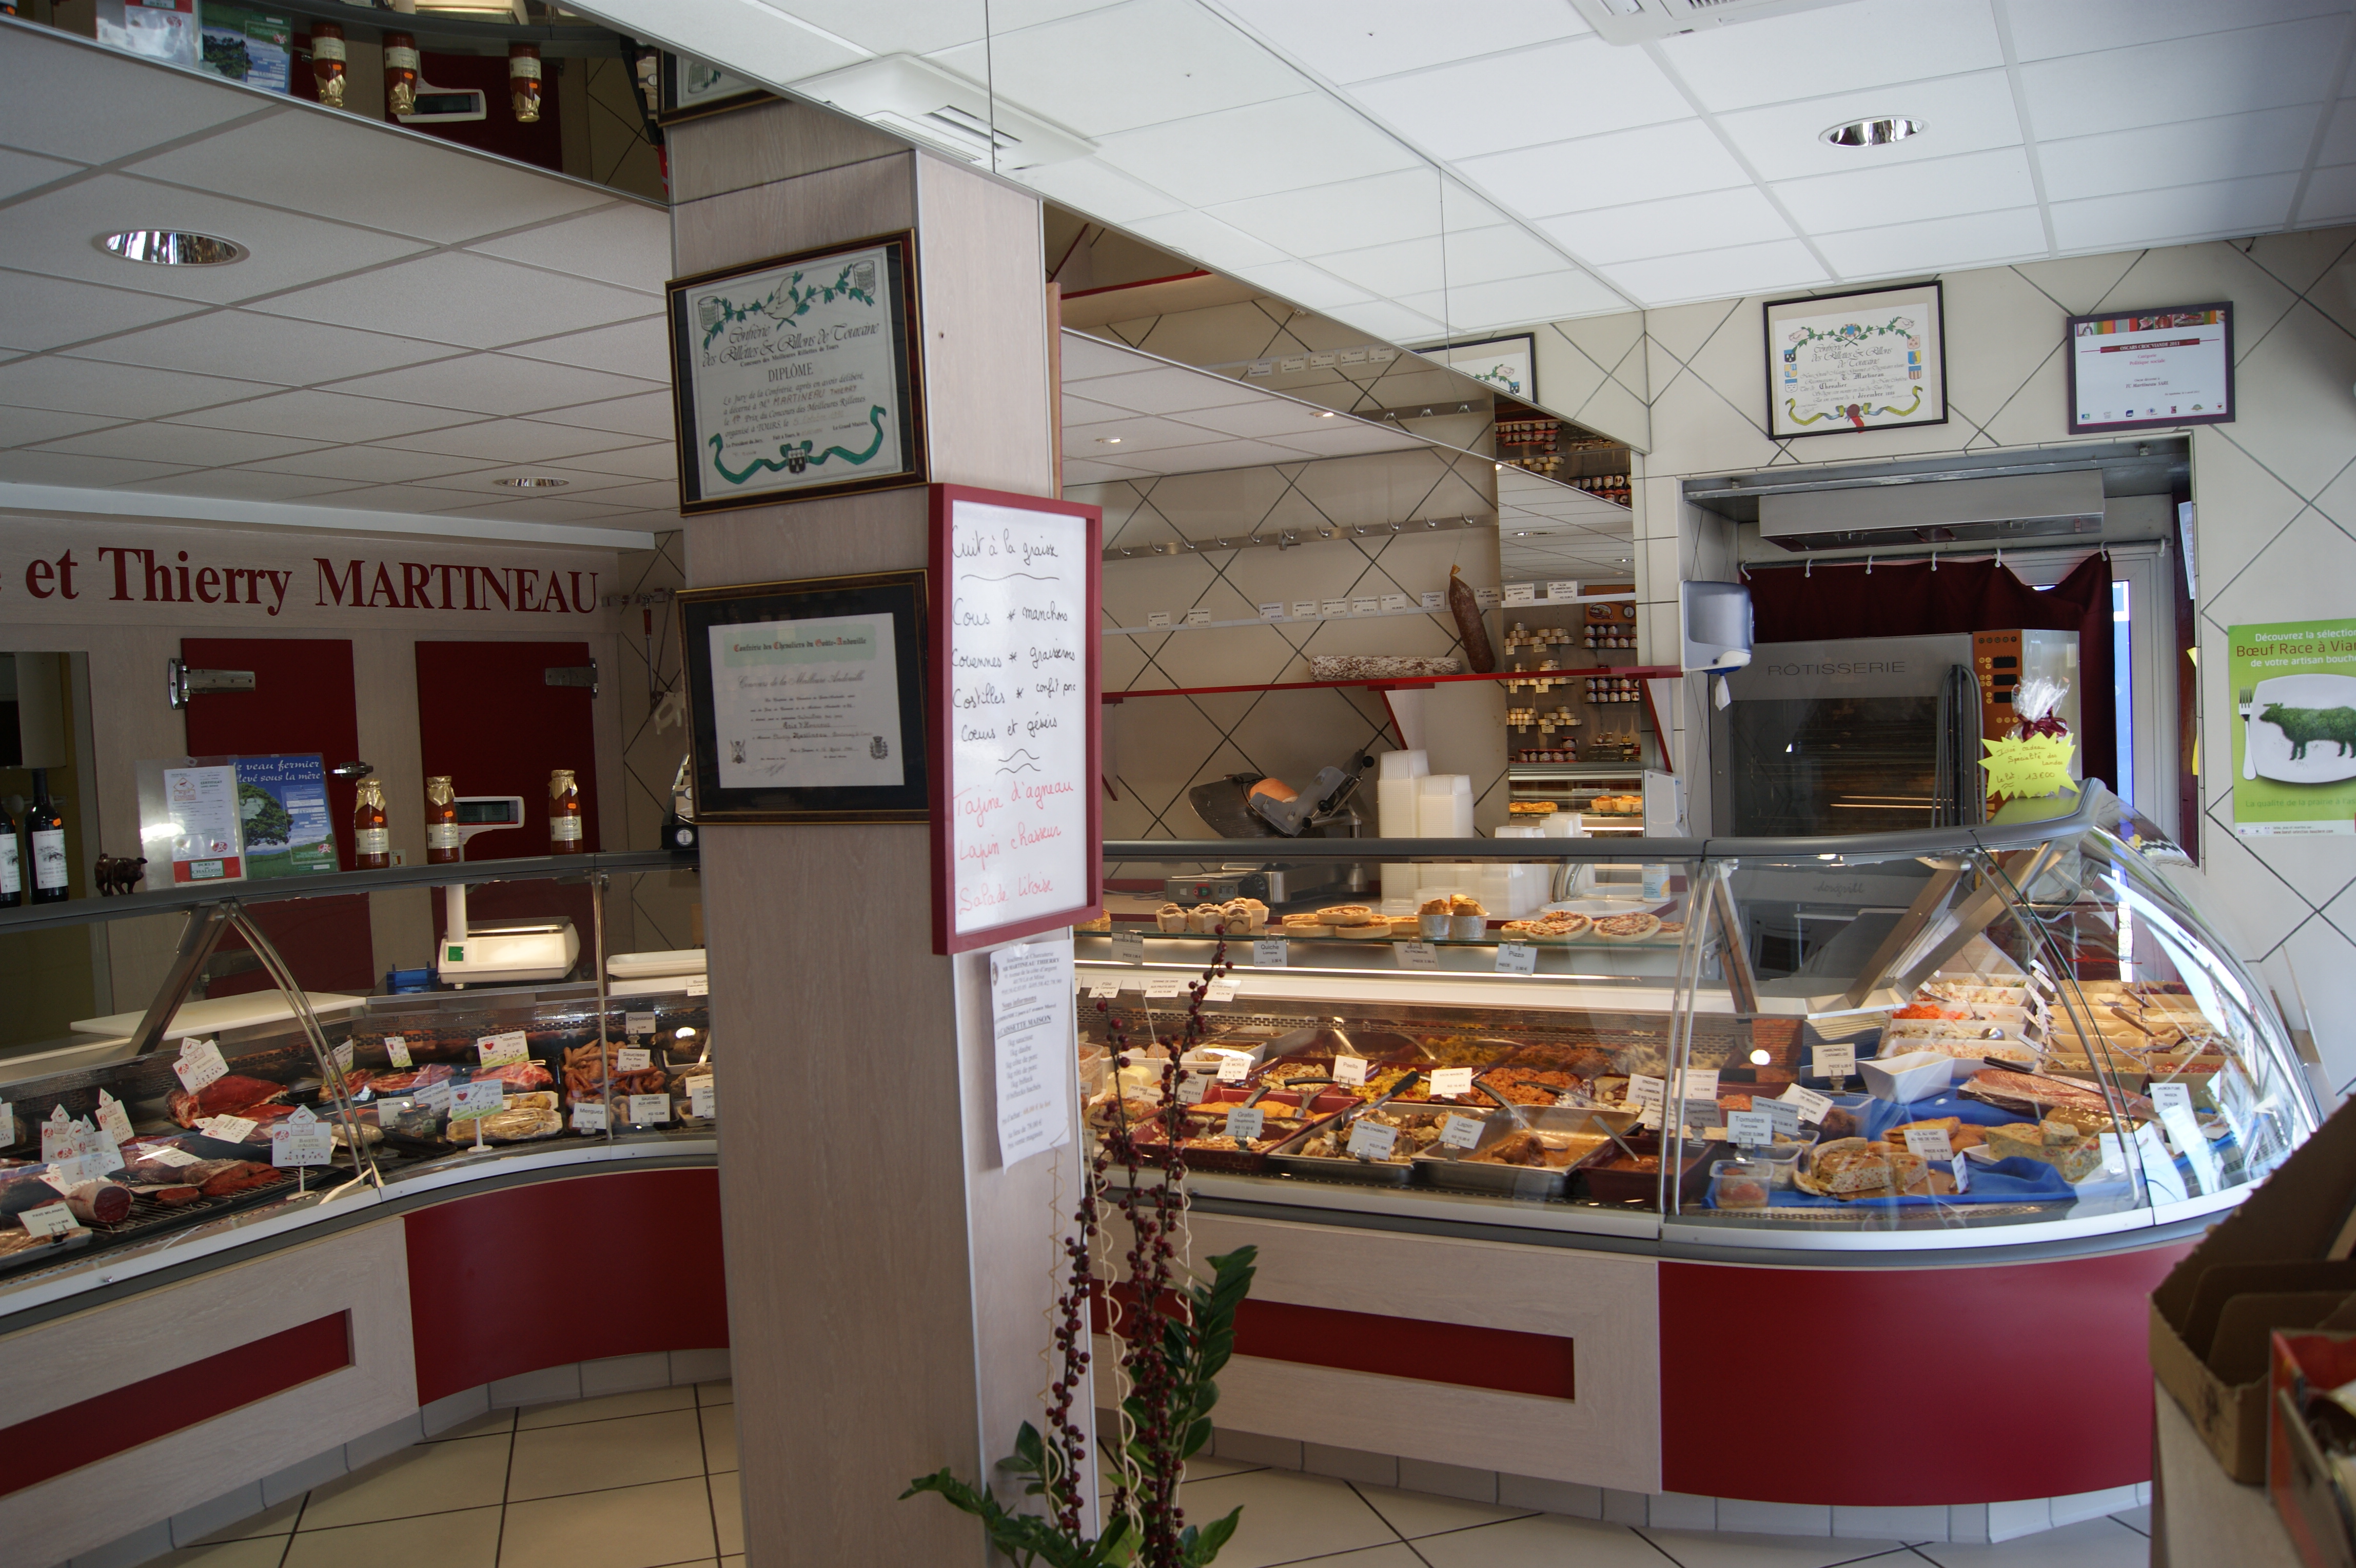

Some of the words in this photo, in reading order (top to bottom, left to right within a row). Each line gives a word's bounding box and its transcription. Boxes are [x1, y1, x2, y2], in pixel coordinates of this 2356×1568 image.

[719, 345, 759, 364] Rillettes
[830, 322, 879, 341] Touraine
[740, 359, 761, 367] Concours
[797, 348, 817, 356] Rillettes
[768, 362, 814, 382] DIPLÔME
[821, 378, 838, 386] avoir
[773, 389, 826, 406] MARTINEAU
[830, 385, 857, 395] THIERRY
[744, 413, 758, 422] Prix
[760, 410, 768, 420] du
[768, 406, 795, 418] Concours
[796, 405, 806, 414] des
[807, 399, 838, 411] Meilleures
[839, 395, 866, 407] Rillettes
[989, 535, 998, 556] à
[1004, 528, 1015, 554] la
[25, 548, 79, 600] et
[98, 546, 292, 616] Thierry
[313, 557, 598, 614] MARTINEAU
[953, 598, 990, 626] Cous
[2255, 632, 2303, 642] Découvrez
[2306, 631, 2314, 639] la
[2279, 643, 2313, 655] Race
[2318, 640, 2325, 653] à
[1768, 661, 1905, 676] RÔTISSERIE
[2265, 658, 2288, 667] votre
[2291, 656, 2323, 665] artisan
[1008, 719, 1018, 736] et
[278, 759, 320, 772] fermier
[2008, 752, 2041, 764] Spécialité
[286, 771, 296, 780] la
[298, 771, 320, 780] mère
[953, 786, 1003, 828] Tajine
[1012, 781, 1074, 809] d'agneau
[2257, 799, 2284, 808] qualité
[2308, 798, 2333, 807] prairie
[960, 835, 999, 870] Lapin
[1011, 821, 1062, 849] chasseur
[959, 883, 1009, 915] Salade
[1028, 1015, 1051, 1026] MAISON
[1457, 1120, 1473, 1128] Lapin
